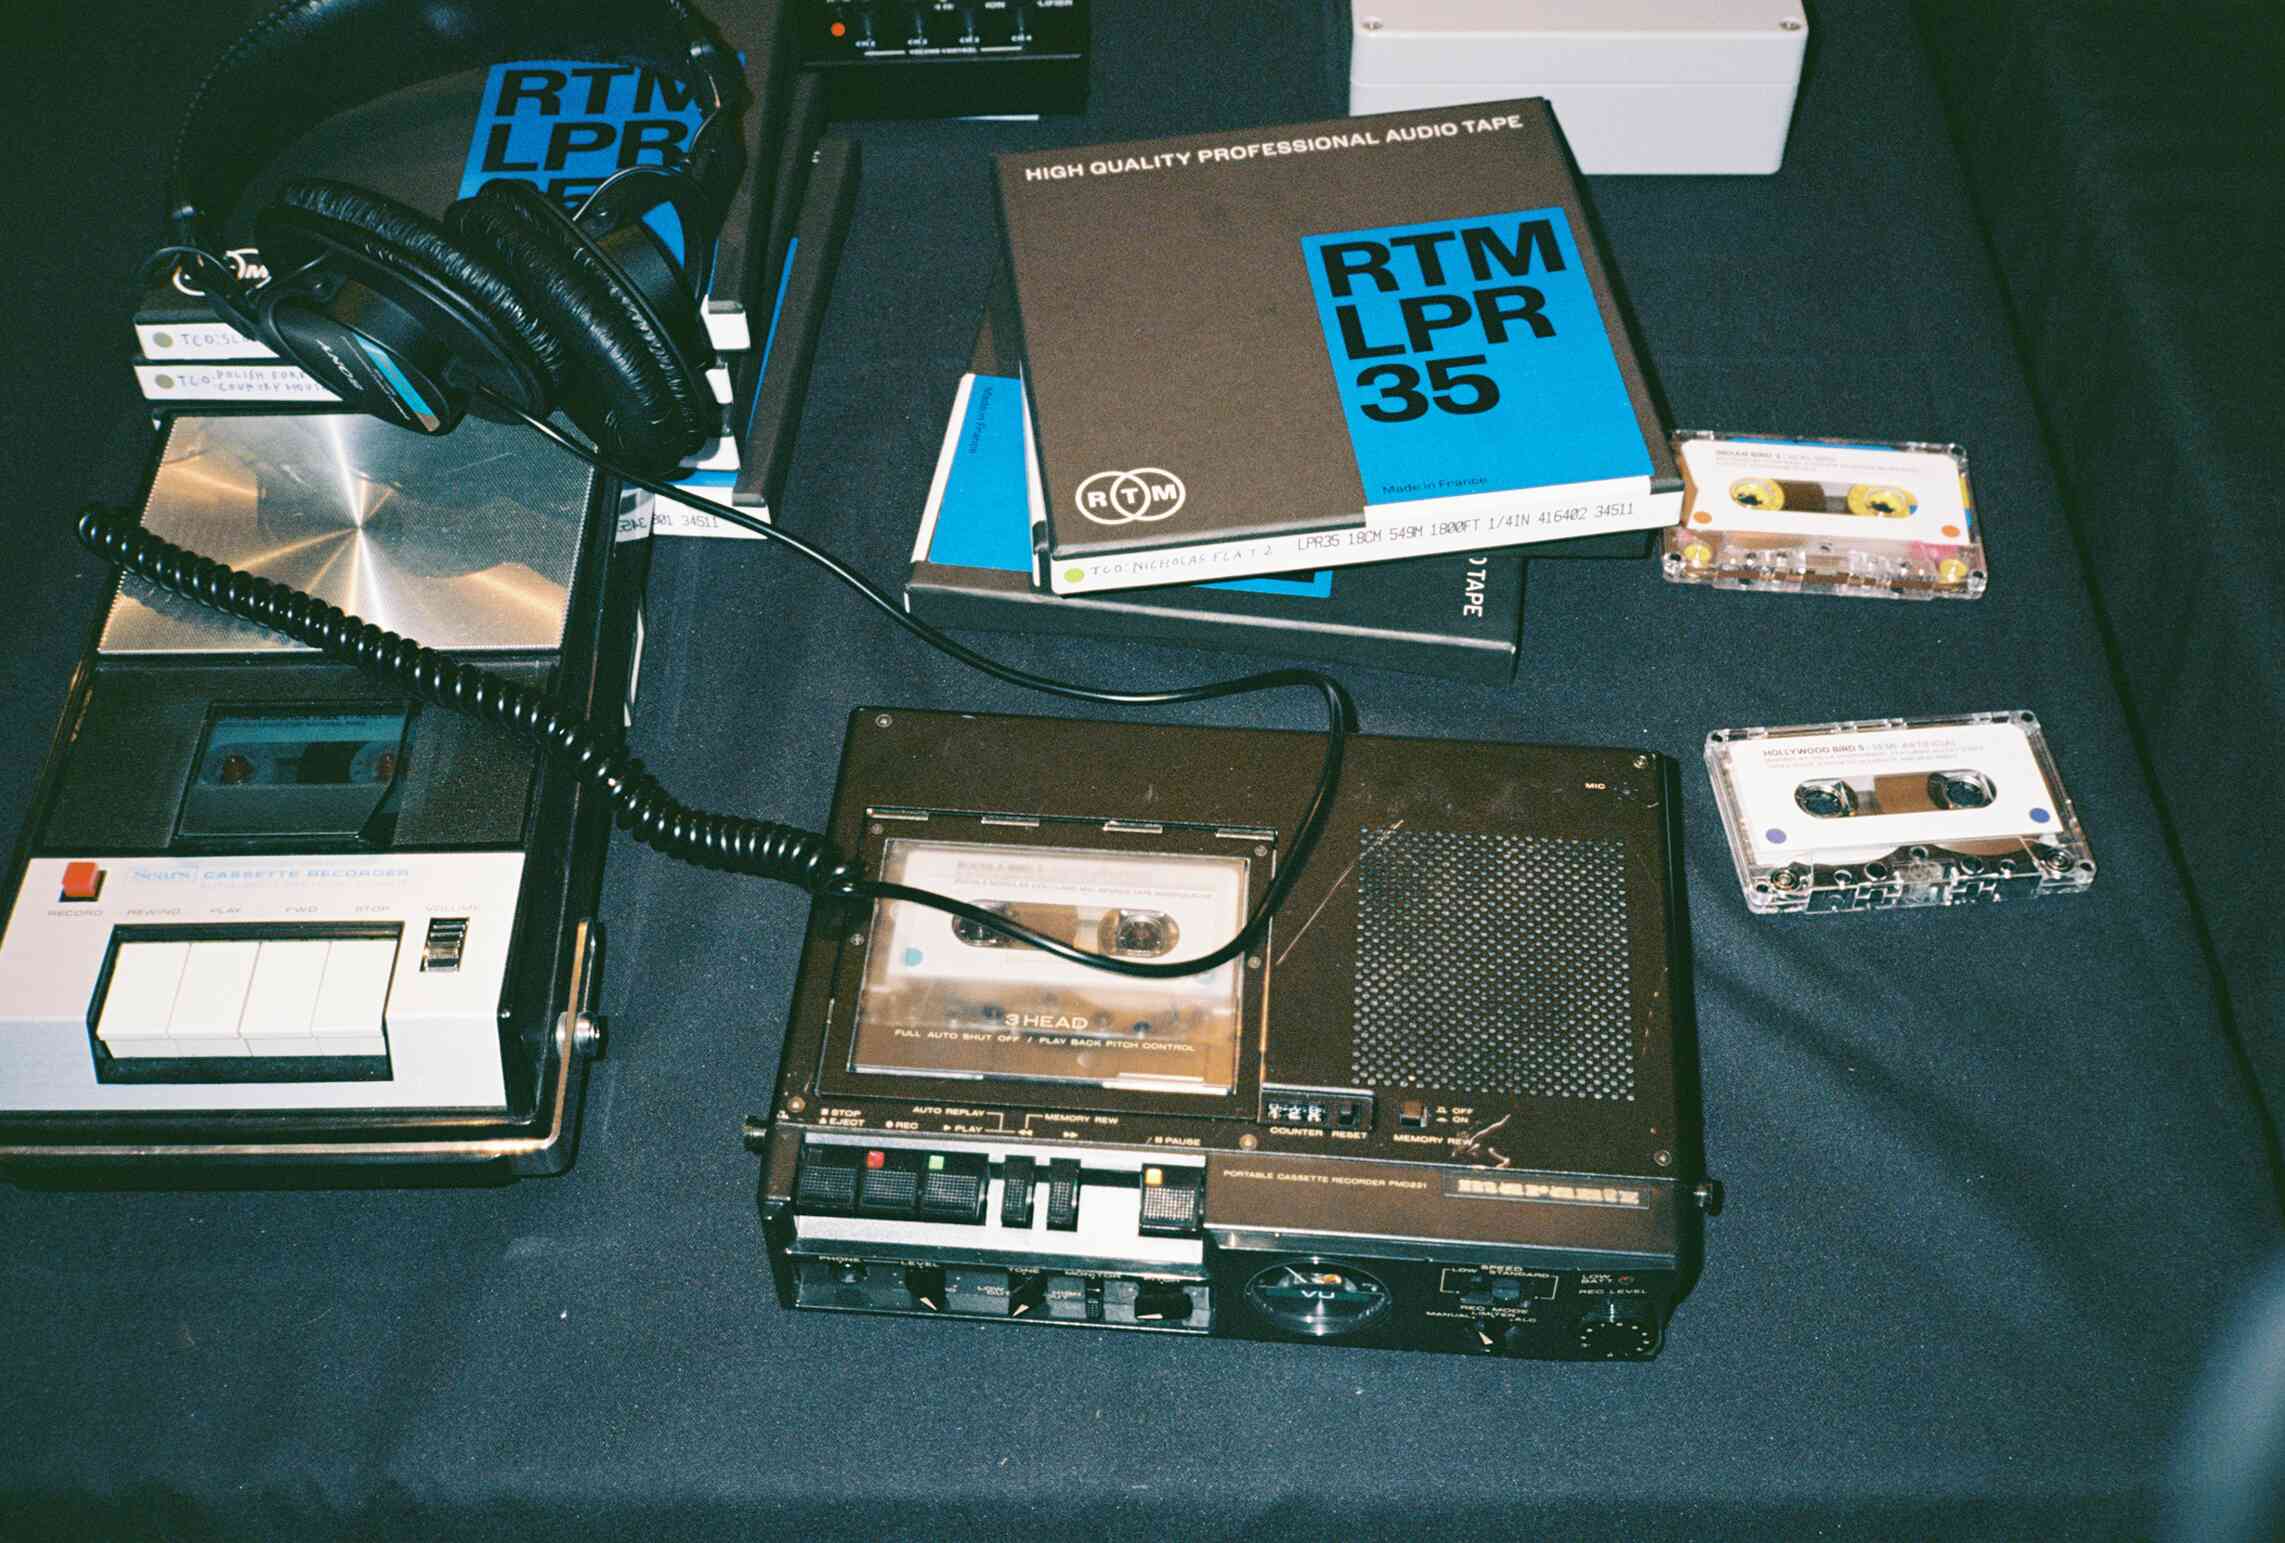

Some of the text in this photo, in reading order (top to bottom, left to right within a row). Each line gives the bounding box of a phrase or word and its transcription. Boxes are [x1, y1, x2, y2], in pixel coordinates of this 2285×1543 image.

[495, 65, 705, 117] RTM
[481, 119, 692, 172] LPR
[1025, 114, 1524, 182] HIGH QUALITY PROFESSIONAL AUDIO TAPE
[1319, 218, 1567, 297] RTM
[1336, 285, 1557, 360] LPR
[1356, 353, 1500, 424] 35
[1382, 475, 1489, 496] Made in France
[1086, 482, 1178, 508] RTM
[1297, 501, 1635, 552] LPR35 18CM 549M 1800FT 1/4IN 416402 34511
[1463, 569, 1487, 618] TAPE
[1763, 746, 1831, 757] HOLLYWOOD
[1584, 782, 1607, 790] MIC
[203, 871, 299, 881] CASSETTE
[303, 868, 410, 880] RECORDER
[47, 909, 104, 917] RECORD
[126, 908, 182, 916] REWIND
[1004, 1013, 1089, 1030] 3 HEAD
[894, 1028, 921, 1038] FULL
[927, 1031, 959, 1040] AUTO
[962, 1033, 993, 1041] SHUT
[997, 1034, 1021, 1043] OFF
[1039, 1037, 1067, 1046] PLAY
[1070, 1038, 1102, 1048] BACK
[1105, 1040, 1139, 1050] PITCH
[1142, 1042, 1196, 1052] CONTROL
[831, 1108, 862, 1117] STOP
[912, 1105, 986, 1118] AUTO REPLAY
[1451, 1107, 1474, 1115] OFF
[828, 1117, 865, 1127] EJECT
[1044, 1112, 1120, 1125] MEMORY REW
[1451, 1115, 1470, 1124] ON
[895, 1121, 920, 1130] REC
[954, 1124, 984, 1134] PLAY
[1269, 1126, 1369, 1140] COUNTER RESET
[1393, 1133, 1473, 1146] MEMORY REW
[1165, 1137, 1201, 1147] PAUSE
[1223, 1170, 1274, 1180] PORTABLE
[1276, 1173, 1330, 1184] CASSETTE
[1332, 1176, 1387, 1187] RECORDER
[1489, 1270, 1551, 1279] STANDARD
[1301, 1289, 1336, 1299] VU
